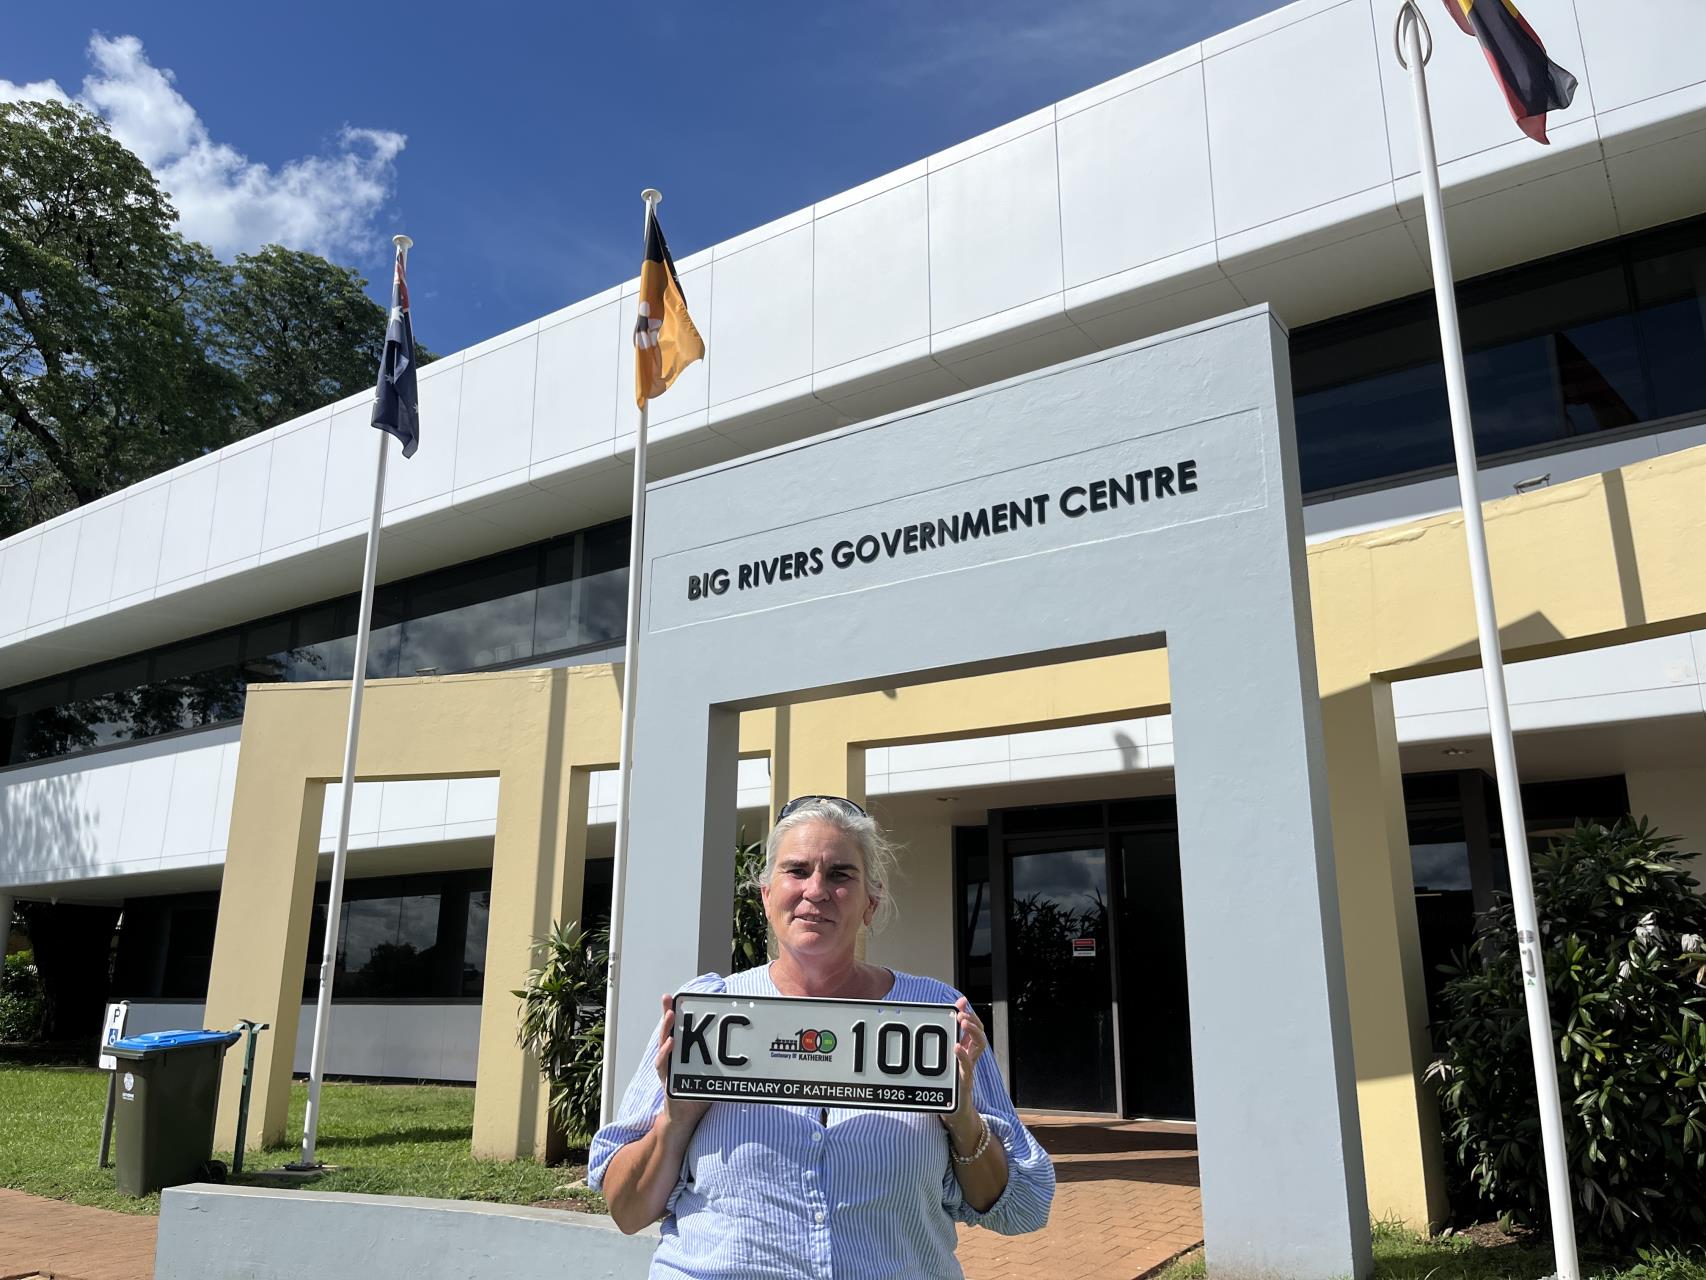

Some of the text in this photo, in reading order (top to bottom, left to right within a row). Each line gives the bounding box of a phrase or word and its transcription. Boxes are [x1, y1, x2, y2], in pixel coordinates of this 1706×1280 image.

[687, 460, 1199, 600] BIG RIVERS GOVERNMENT CENTRE
[680, 1012, 948, 1077] KC 100
[798, 1054, 833, 1062] KATHERINE
[681, 1078, 703, 1090] N.T.
[706, 1079, 780, 1094] CENTENARY
[783, 1083, 800, 1095] OF
[803, 1084, 874, 1099] KATHERINE
[877, 1088, 905, 1101] 1926
[915, 1090, 944, 1103] 2026
